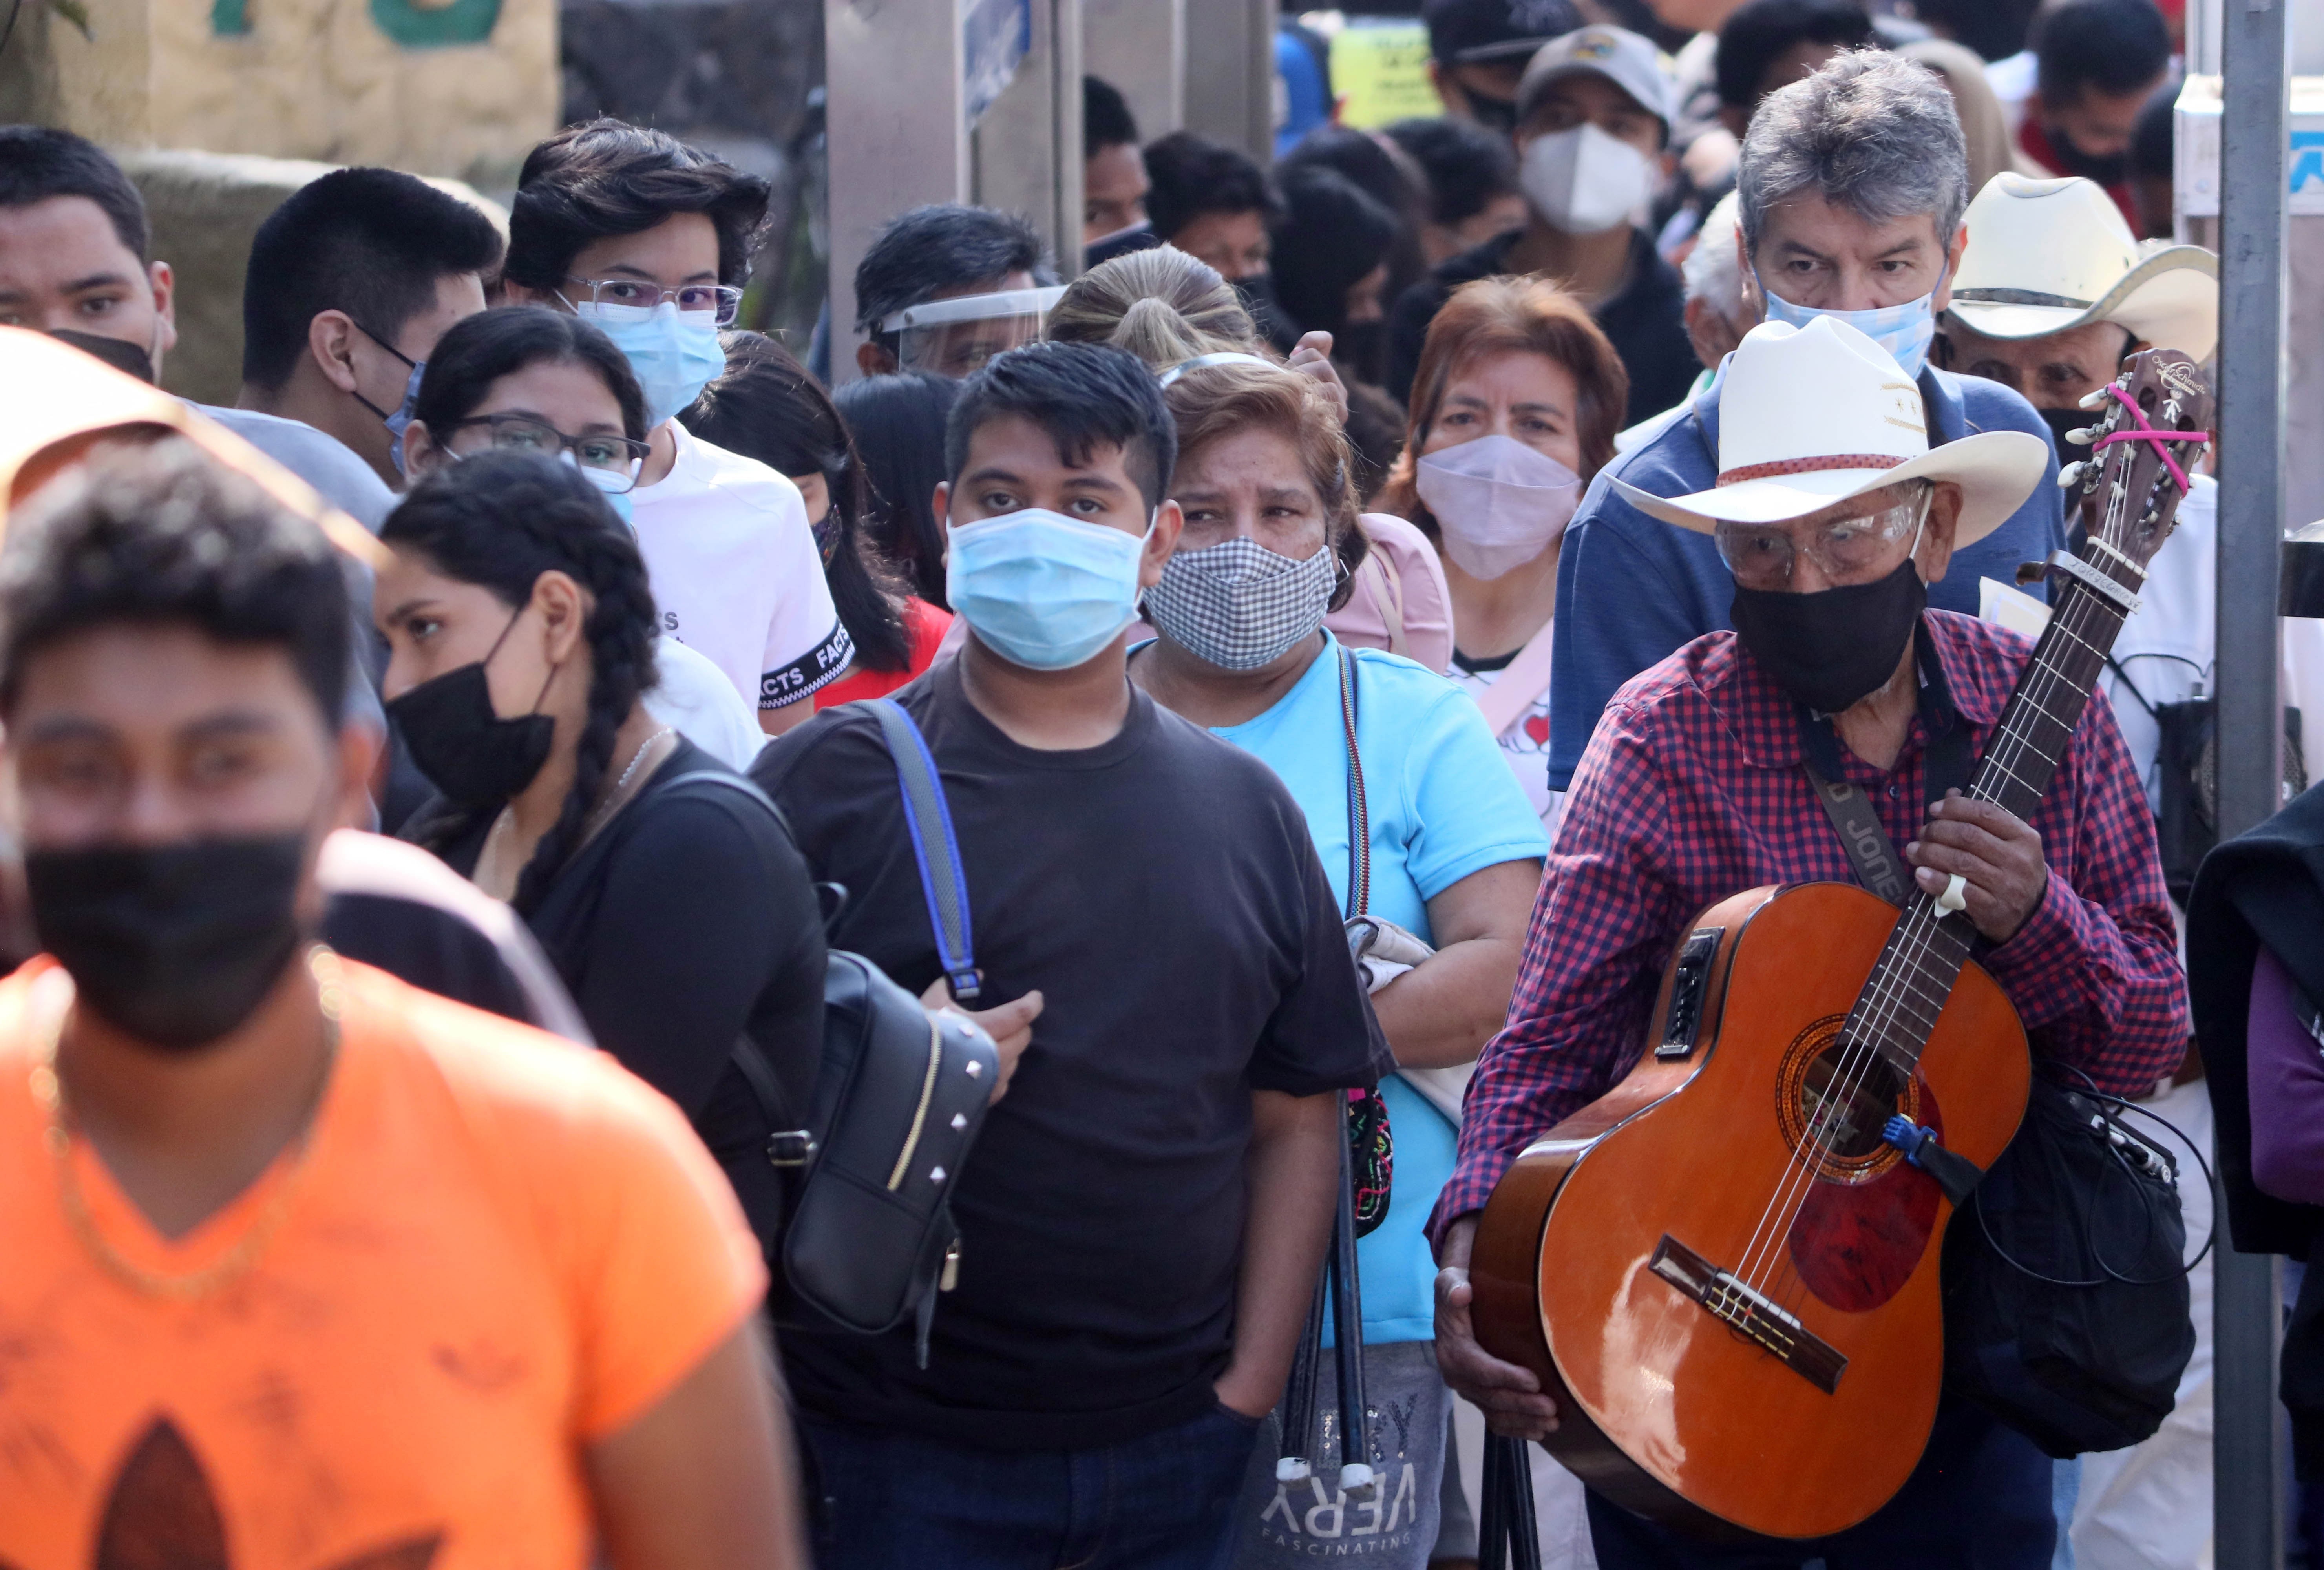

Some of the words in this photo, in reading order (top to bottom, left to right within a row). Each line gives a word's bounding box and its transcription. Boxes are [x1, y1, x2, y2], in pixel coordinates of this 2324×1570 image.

[760, 667, 804, 696] CTS
[815, 623, 848, 669] FACTS
[1846, 820, 1903, 901] JONE
[1261, 1528, 1411, 1557] FASCINATING
